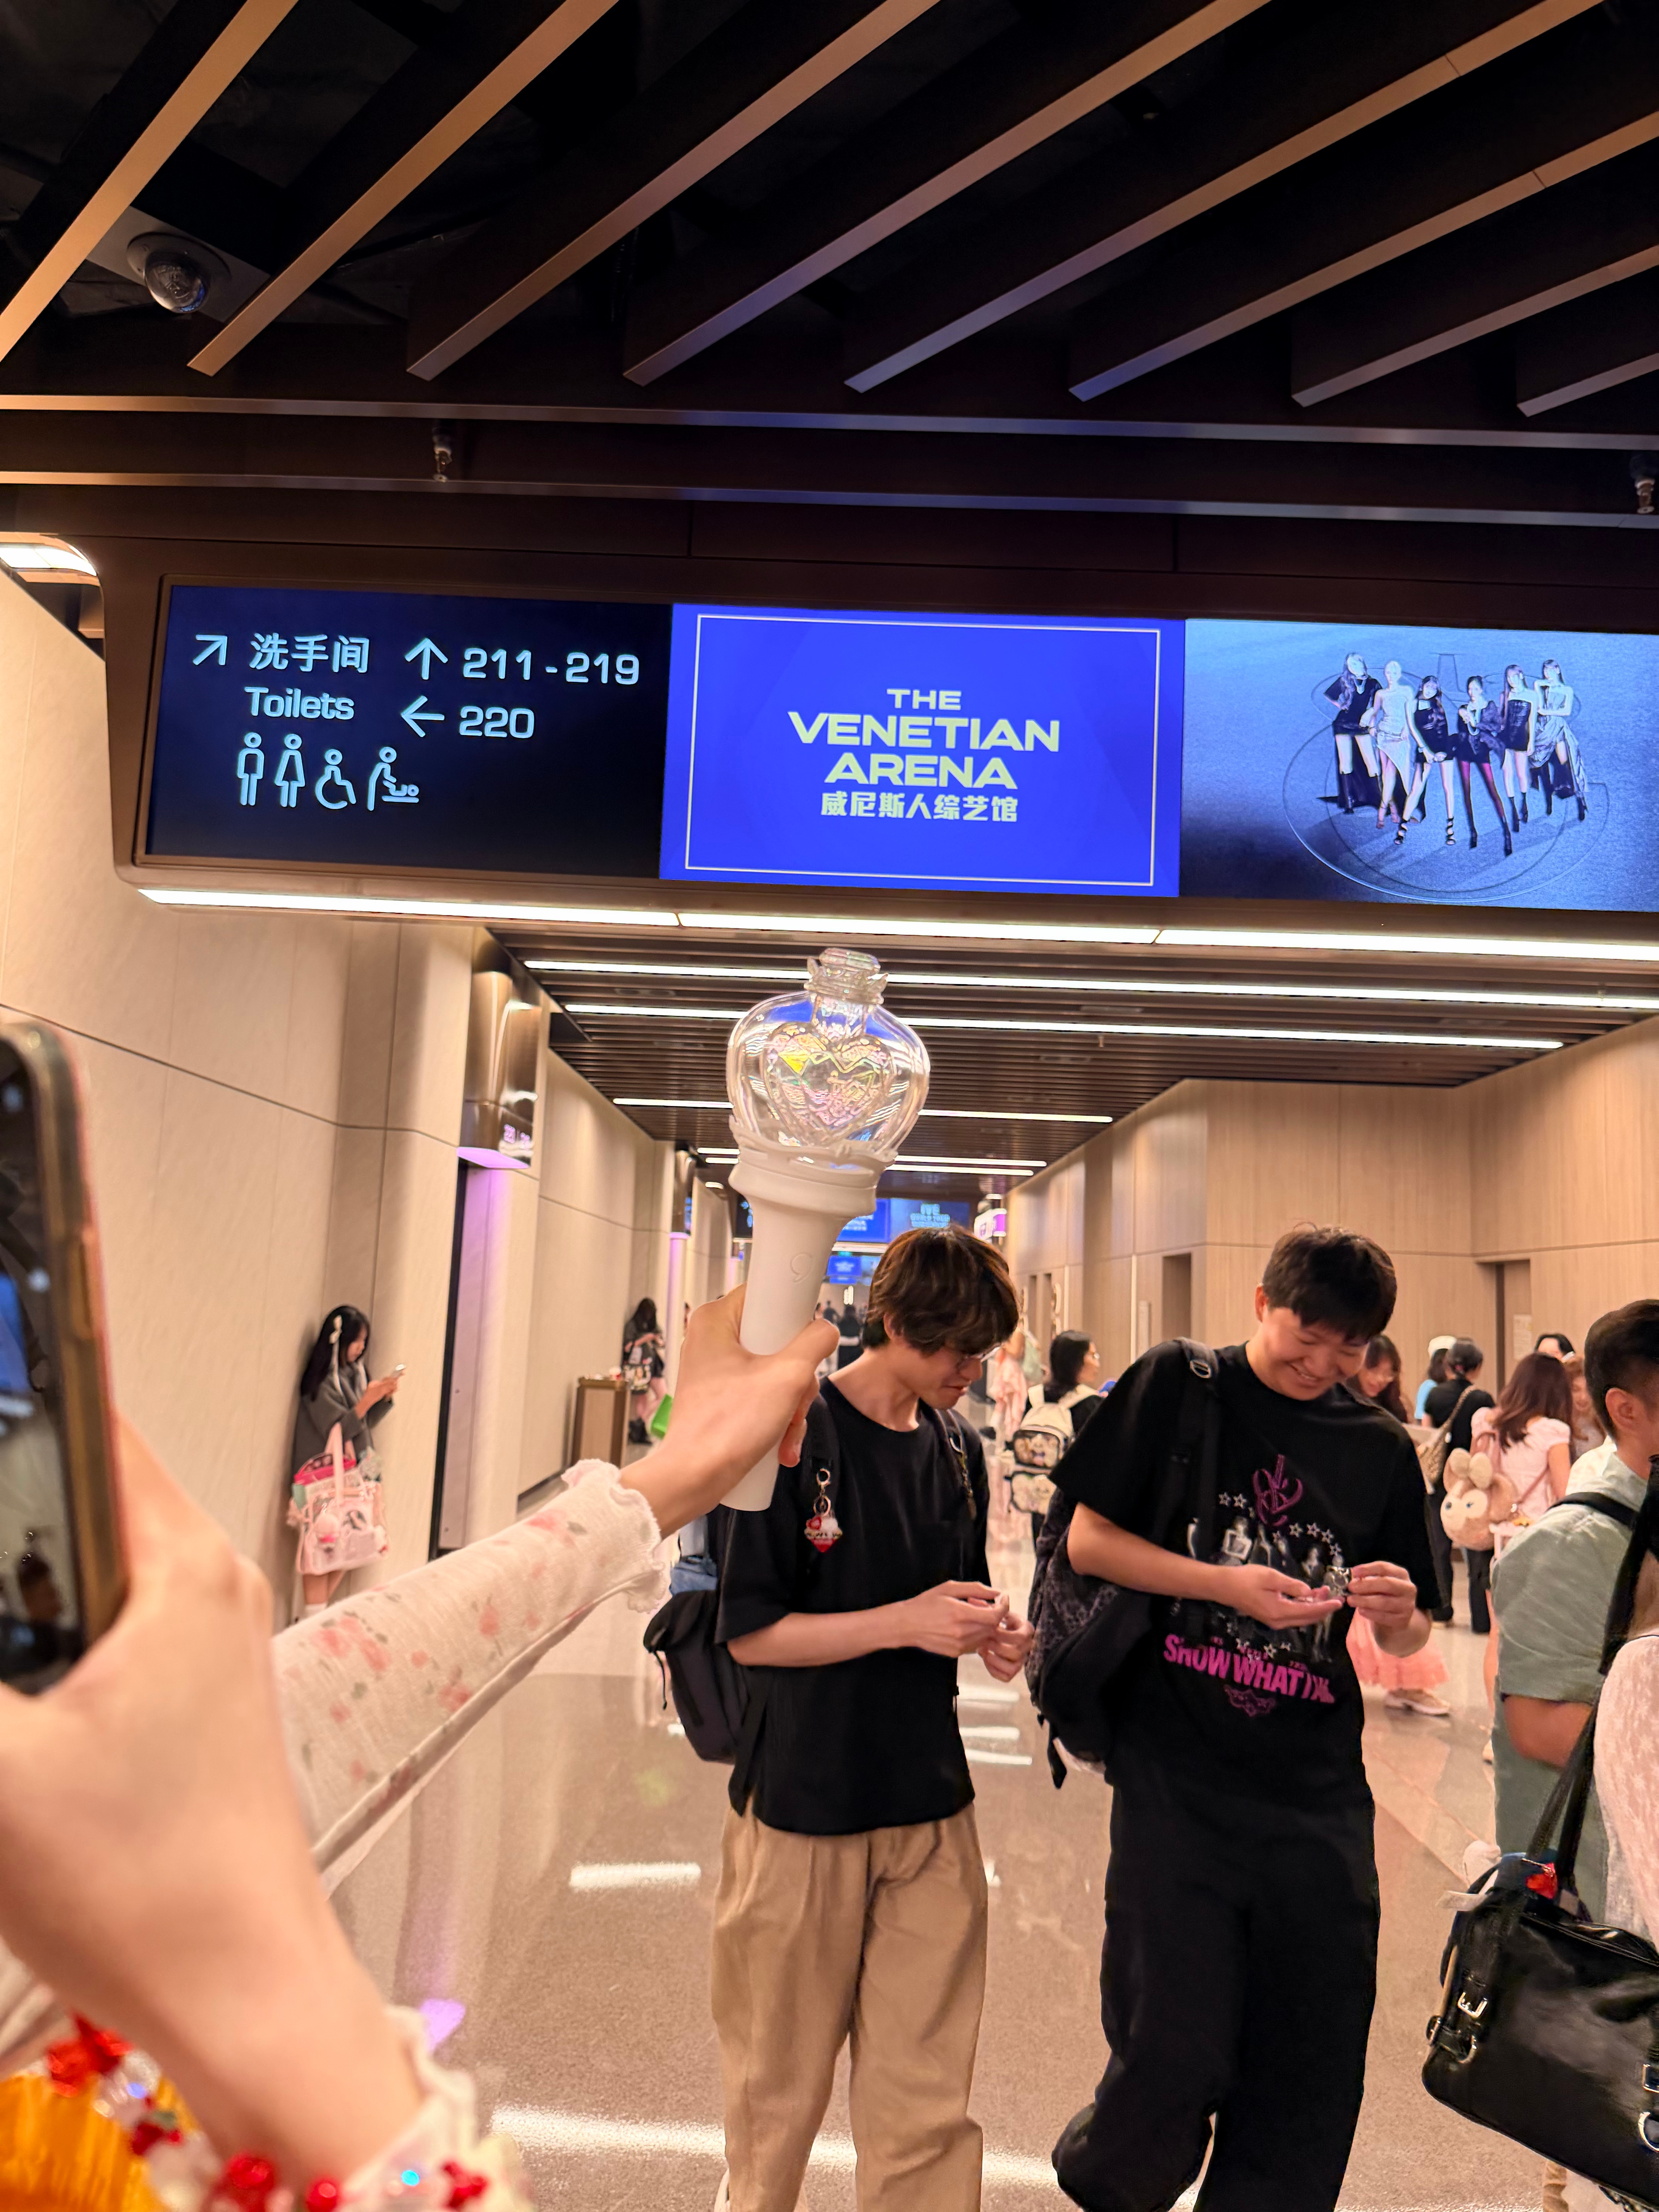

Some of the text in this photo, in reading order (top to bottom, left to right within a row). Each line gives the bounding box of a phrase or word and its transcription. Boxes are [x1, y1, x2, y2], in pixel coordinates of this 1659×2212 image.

[249, 632, 370, 673] 洗手间
[463, 648, 532, 680] 211
[565, 652, 639, 685] 219
[244, 686, 355, 720] Toilets
[886, 689, 962, 711] THE
[459, 706, 535, 739] 220
[787, 711, 1060, 752] VENETIAN
[824, 752, 1018, 790] ARENA
[821, 790, 1018, 822] 威尼斯人综艺馆
[1163, 1633, 1231, 1679] SHOW
[1233, 1653, 1305, 1697] WHAT
